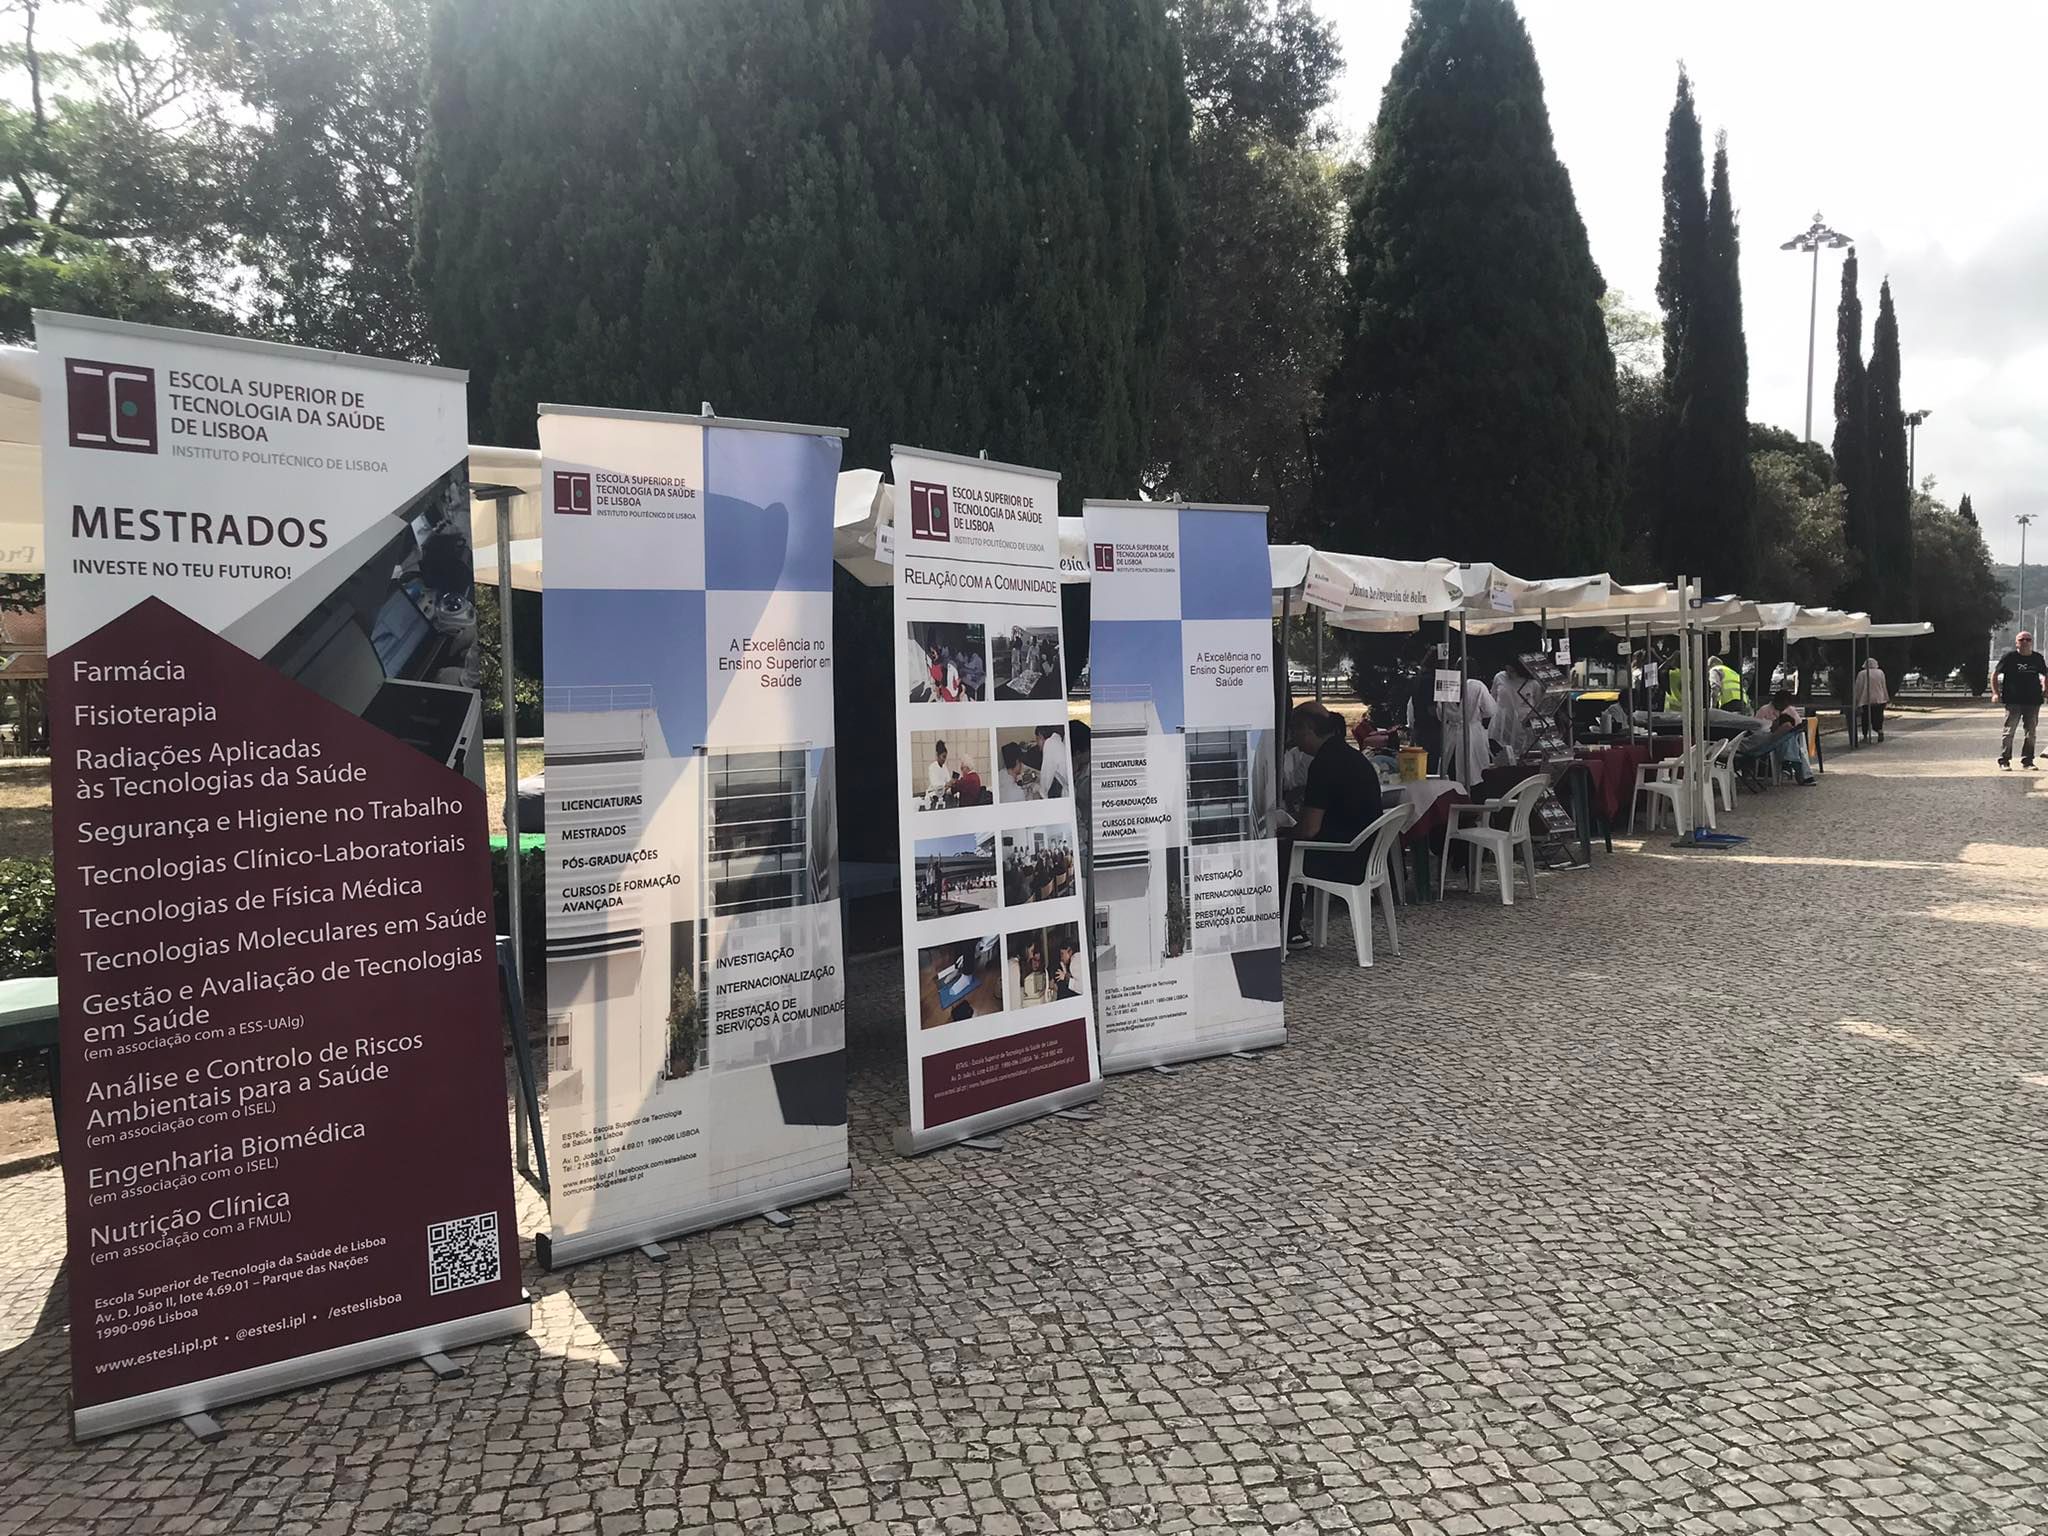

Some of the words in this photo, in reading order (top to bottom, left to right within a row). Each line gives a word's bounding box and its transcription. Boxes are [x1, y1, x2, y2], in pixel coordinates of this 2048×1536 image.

[169, 370, 243, 397] ESCOLA
[248, 380, 338, 406] SUPERIOR
[341, 390, 364, 408] DE
[170, 394, 292, 422] TECNOLOGIA
[296, 407, 322, 425] DA
[327, 409, 385, 431] SAÚDE
[170, 417, 198, 436] DE
[202, 420, 269, 442] LISBOA
[172, 445, 240, 462] INSTITUTO
[242, 450, 324, 468] POLITÉCNICO
[327, 458, 342, 469] DE
[346, 459, 389, 473] LISBOA
[596, 474, 630, 484] ESCOLA
[632, 476, 673, 486] SUPERIOR
[674, 477, 686, 486] DE
[596, 484, 652, 496] TECNOLOGIA
[654, 487, 667, 496] DA
[668, 487, 695, 498] SAÚDE
[597, 496, 610, 506] DE
[612, 497, 641, 506] LISBOA
[953, 486, 982, 501] ESCOLA
[984, 491, 1021, 506] SUPERIOR
[1023, 496, 1033, 508] DE
[953, 502, 1004, 518] TECNOLOGIA
[1005, 508, 1016, 519] DA
[1018, 509, 1042, 524] SAÚDE
[954, 517, 964, 529] DE
[965, 518, 994, 532] LISBOA
[71, 505, 328, 549] MESTRADOS
[73, 559, 147, 576] INVESTE
[152, 561, 178, 577] NO
[182, 562, 214, 578] TEU
[219, 563, 292, 580] FUTURO!
[730, 639, 739, 651] A
[742, 638, 811, 651] Excelência
[813, 640, 825, 651] no
[1197, 653, 1203, 661] A
[1205, 652, 1248, 661] Excelência
[73, 660, 185, 682] Farmácia
[719, 657, 762, 670] Ensino
[766, 656, 817, 671] Superior
[1190, 666, 1217, 675] Ensino
[1219, 665, 1253, 676] Superior
[1256, 665, 1268, 673] em
[760, 674, 802, 688] Saúde
[1216, 678, 1243, 686] Saúde
[75, 702, 217, 727] Fisioterapia
[76, 745, 201, 771] Radiações
[209, 738, 321, 766] Aplicadas
[1100, 759, 1146, 768] LICENCIATURAS
[77, 779, 104, 799] às
[110, 771, 253, 797] Tecnologias
[261, 767, 288, 787] da
[296, 763, 367, 785] Saúde
[561, 795, 642, 811] LICENCIATURAS
[1102, 797, 1157, 808] PÓS-GRADUAÇÕES
[78, 817, 209, 846] Segurança
[217, 816, 230, 831] e
[238, 808, 327, 832] Higiene
[335, 807, 364, 822] no
[368, 796, 463, 820] Trabalho
[562, 825, 626, 840] MESTRADOS
[77, 855, 227, 886] Tecnologias
[234, 834, 465, 870] Clínico-Laboratoriais
[562, 850, 658, 869] PÓS-GRADUAÇÕES
[562, 884, 606, 898] CURSOS
[609, 883, 621, 893] DE
[624, 874, 681, 891] FORMAÇÃO
[1194, 870, 1243, 882] INVESTIGAÇÃO
[79, 896, 228, 929] Tecnologias
[236, 890, 265, 911] de
[273, 887, 334, 908] Física
[342, 877, 422, 901] Médica
[562, 897, 623, 912] AVANÇADA
[1194, 886, 1272, 901] INTERNACIONALIZAÇÃO
[80, 937, 230, 972] Tecnologias
[238, 922, 378, 952] Moleculares
[385, 920, 418, 935] em
[426, 907, 486, 931] Saúde
[716, 947, 794, 969] INVESTIGAÇÃO
[83, 986, 172, 1015] Gestão
[179, 985, 193, 999] e
[201, 966, 314, 998] Avaliação
[321, 962, 350, 981] de
[355, 947, 482, 977] Tecnologias
[716, 966, 835, 995] INTERNACIONALIZAÇÃO
[716, 1001, 780, 1022] PRESTAÇÃO
[783, 999, 797, 1012] DE
[716, 1016, 769, 1035] SERVIÇOS
[772, 1013, 780, 1024] À
[782, 1000, 845, 1022] COMUNIDADE
[84, 1022, 125, 1043] em
[134, 1006, 210, 1035] Saúde
[84, 1049, 112, 1061] (em
[116, 1033, 191, 1056] associação
[195, 1026, 224, 1041] com
[228, 1025, 236, 1036] a
[239, 1014, 304, 1034] ESS-UAlg)
[86, 1072, 178, 1102] Análise
[186, 1069, 200, 1083] e
[207, 1048, 312, 1079] Controlo
[319, 1042, 348, 1062] de
[355, 1034, 423, 1057] Riscos
[87, 1088, 231, 1130] Ambientais
[239, 1081, 291, 1106] para
[299, 1077, 311, 1091] a
[318, 1062, 389, 1088] Saúde
[89, 1144, 233, 1189] Engenharia
[241, 1121, 365, 1157] Biomédica
[91, 1209, 201, 1247] Nutrição
[209, 1191, 290, 1219] Clínica
[90, 1251, 119, 1266] (em
[123, 1232, 199, 1257] associação
[203, 1223, 233, 1239] com
[237, 1222, 245, 1231] a
[248, 1211, 292, 1229] FMUL)
[95, 1292, 134, 1308] Escola
[137, 1279, 191, 1301] Superior
[194, 1273, 209, 1285] de
[211, 1260, 276, 1283] Tecnologia
[278, 1255, 294, 1266] da
[296, 1248, 332, 1263] Saúde
[334, 1244, 348, 1255] de
[351, 1236, 387, 1251] Lisboa
[95, 1313, 115, 1325] Av.
[118, 1308, 131, 1320] D.
[133, 1301, 162, 1316] João
[162, 1298, 177, 1312] II,
[179, 1291, 203, 1306] lote
[206, 1280, 249, 1298] 4.69.01
[262, 1271, 303, 1287] Parque
[306, 1263, 326, 1276] das
[329, 1254, 369, 1272] Nações
[95, 1335, 218, 1375] www.estesl.ipl.pt
[235, 1314, 306, 1341] @estesl.ipl
[328, 1292, 402, 1320] /esteslisboa
[96, 1318, 156, 1340] 1990-096
[159, 1307, 199, 1325] Lisboa
